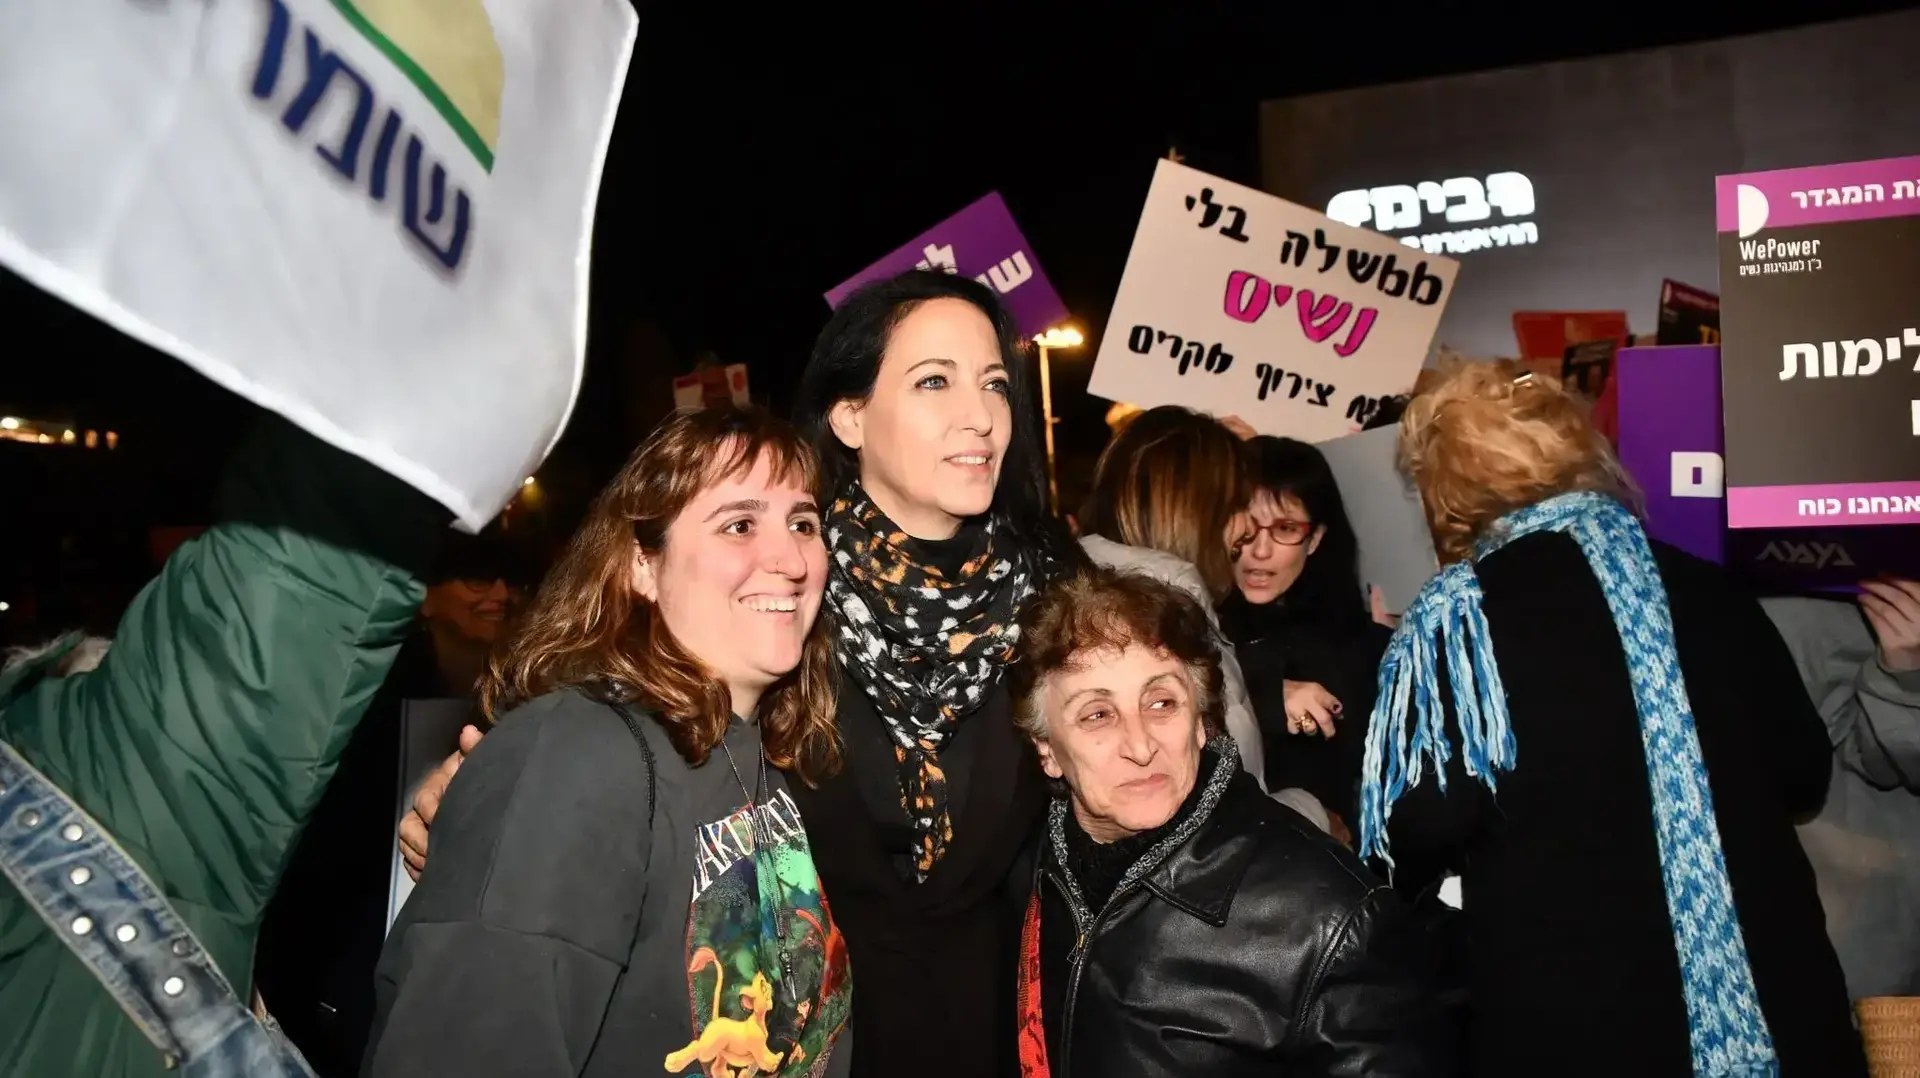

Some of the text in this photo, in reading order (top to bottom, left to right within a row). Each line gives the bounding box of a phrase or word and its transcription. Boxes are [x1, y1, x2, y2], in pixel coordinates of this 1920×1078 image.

[1790, 177, 1920, 209] ת המגדר
[1185, 187, 1443, 306] ממשלה בלי
[1738, 237, 1822, 262] WePower
[1739, 264, 1761, 277] נשים
[1223, 269, 1379, 358] נשים
[1127, 324, 1234, 376] מקרים
[1255, 362, 1336, 408] צירוף
[1798, 495, 1920, 516] אנחנו כוח
